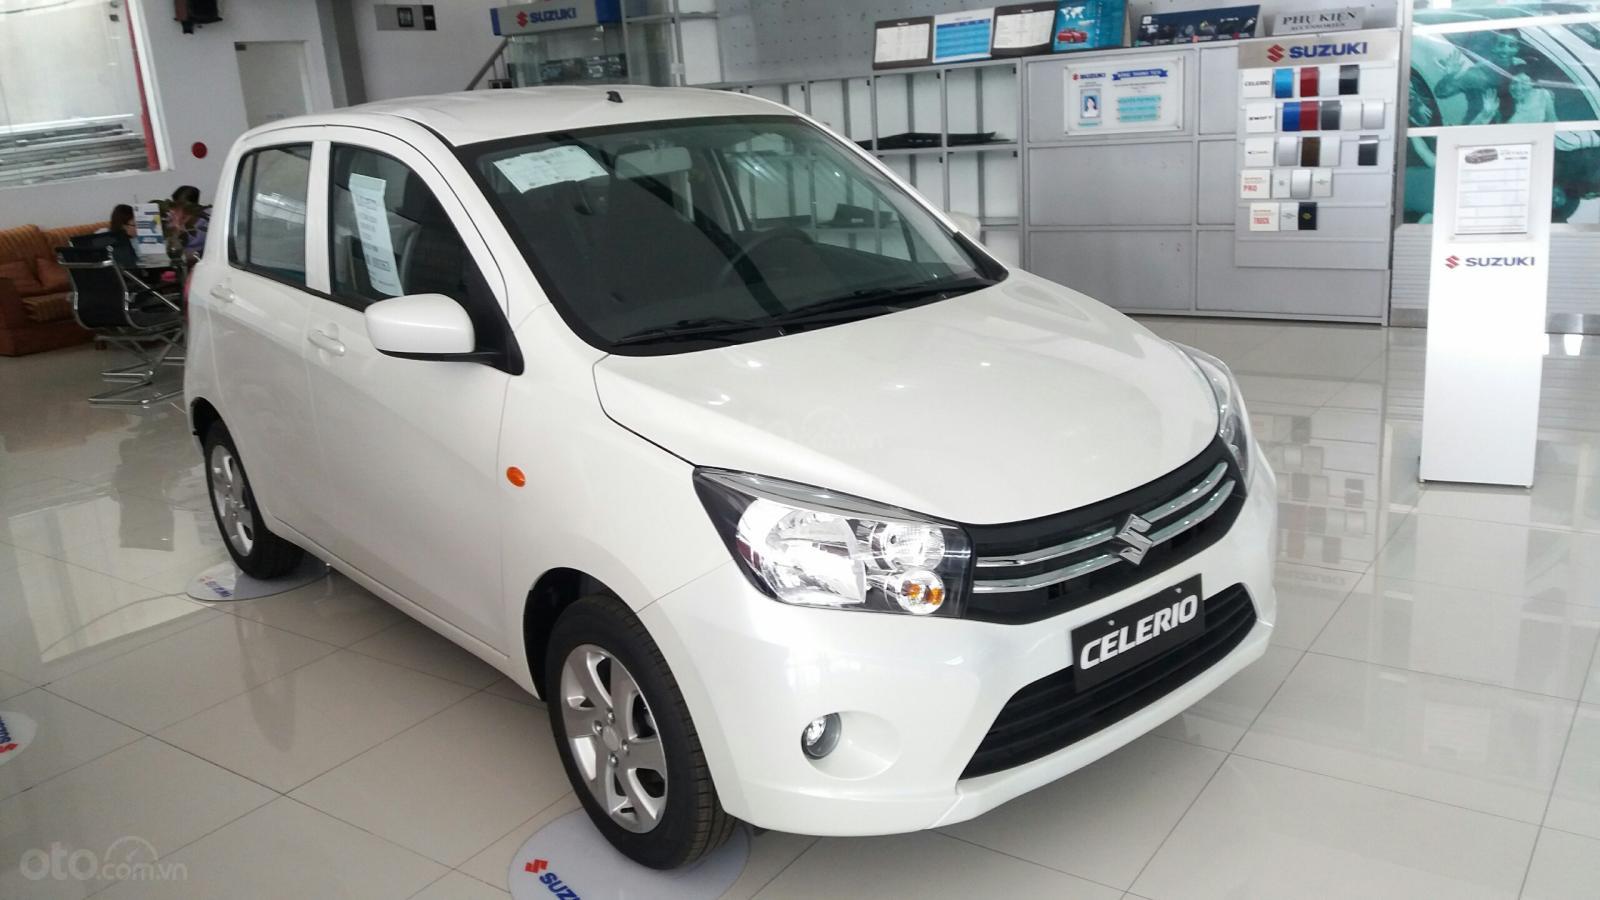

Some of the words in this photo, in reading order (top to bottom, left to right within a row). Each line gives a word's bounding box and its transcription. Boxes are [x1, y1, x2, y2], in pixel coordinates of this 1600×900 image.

[529, 7, 577, 24] SUZUKI
[1289, 42, 1368, 59] SUZUKI
[1465, 256, 1535, 267] SUZUKI
[1080, 595, 1198, 670] CELERIO
[539, 873, 582, 900] SUZ
